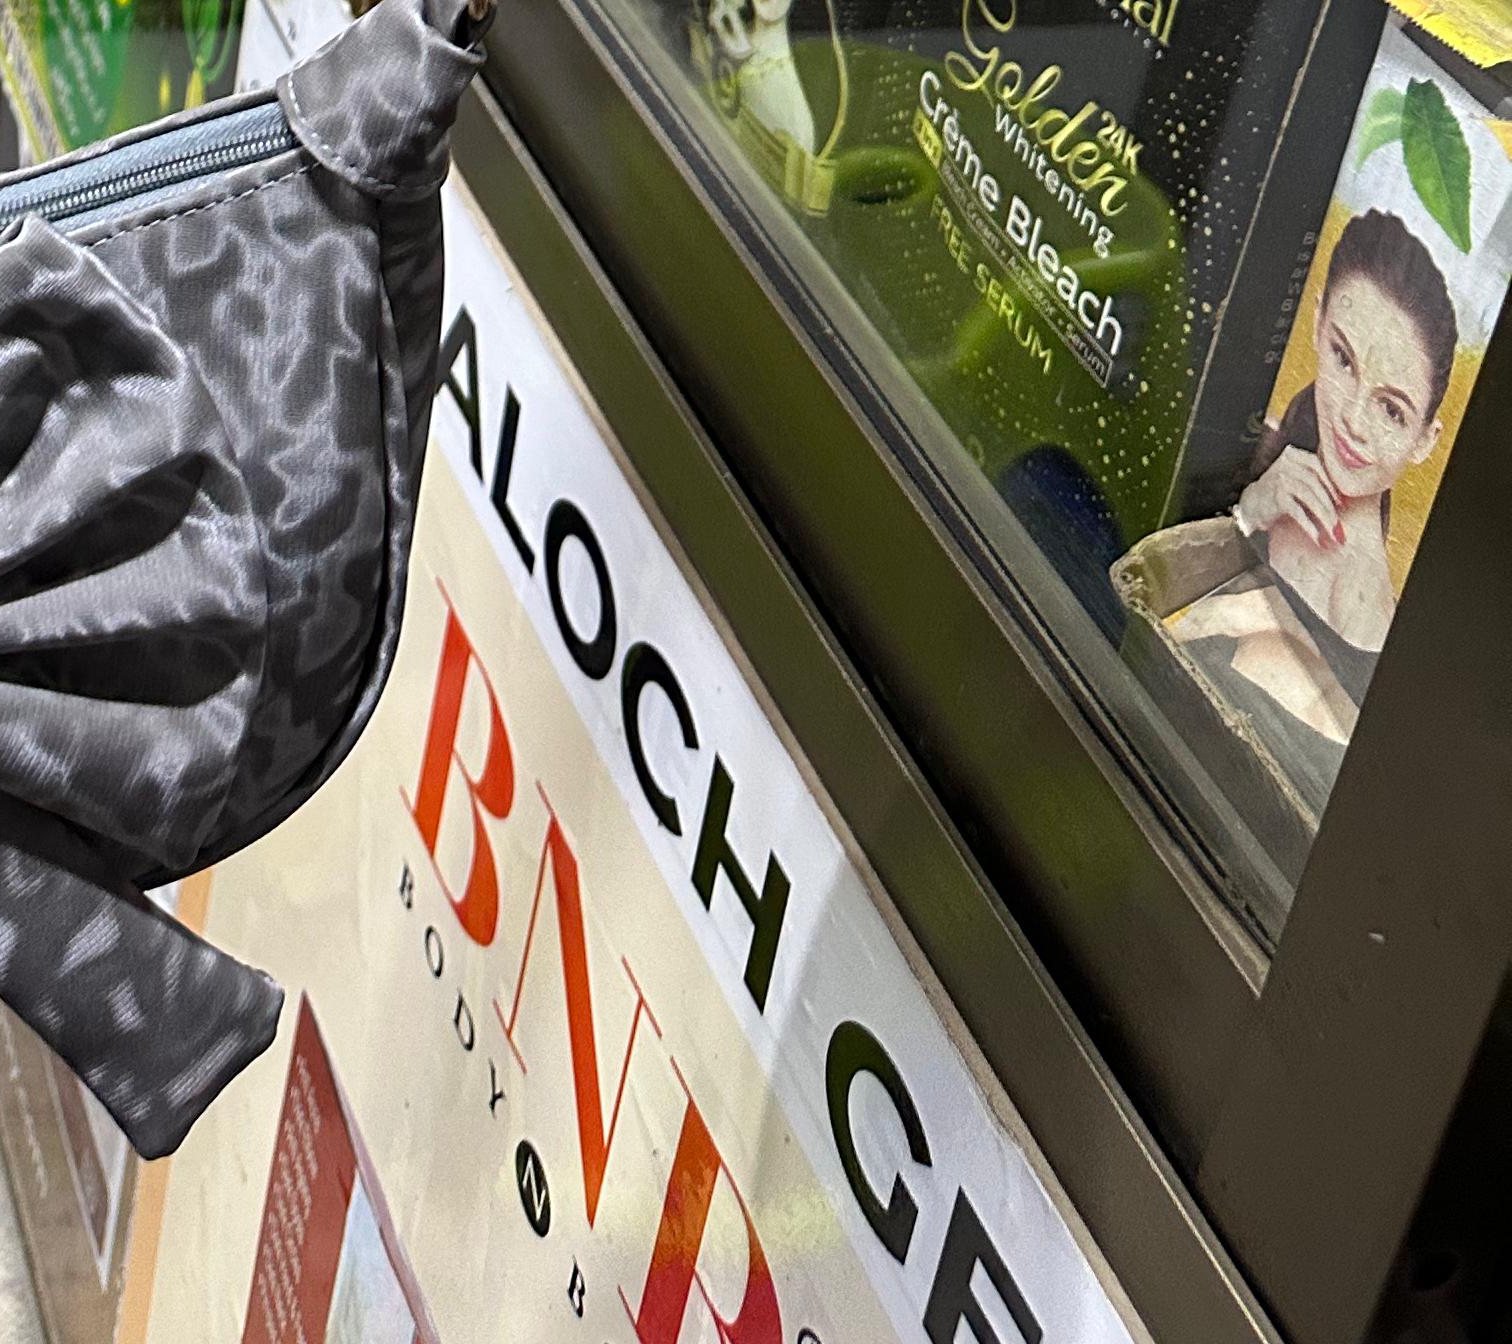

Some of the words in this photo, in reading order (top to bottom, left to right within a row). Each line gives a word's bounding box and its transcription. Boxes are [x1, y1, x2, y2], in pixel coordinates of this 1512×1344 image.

[918, 69, 1001, 212] Crème
[1004, 193, 1123, 357] Bleach
[994, 104, 1116, 260] Whitening
[1096, 110, 1144, 176] 24K
[931, 190, 972, 274] FREE
[973, 260, 1053, 376] SERUM
[1065, 318, 1108, 378] Serum
[434, 304, 792, 1017] ALOCH
[397, 856, 506, 1120] BODY
